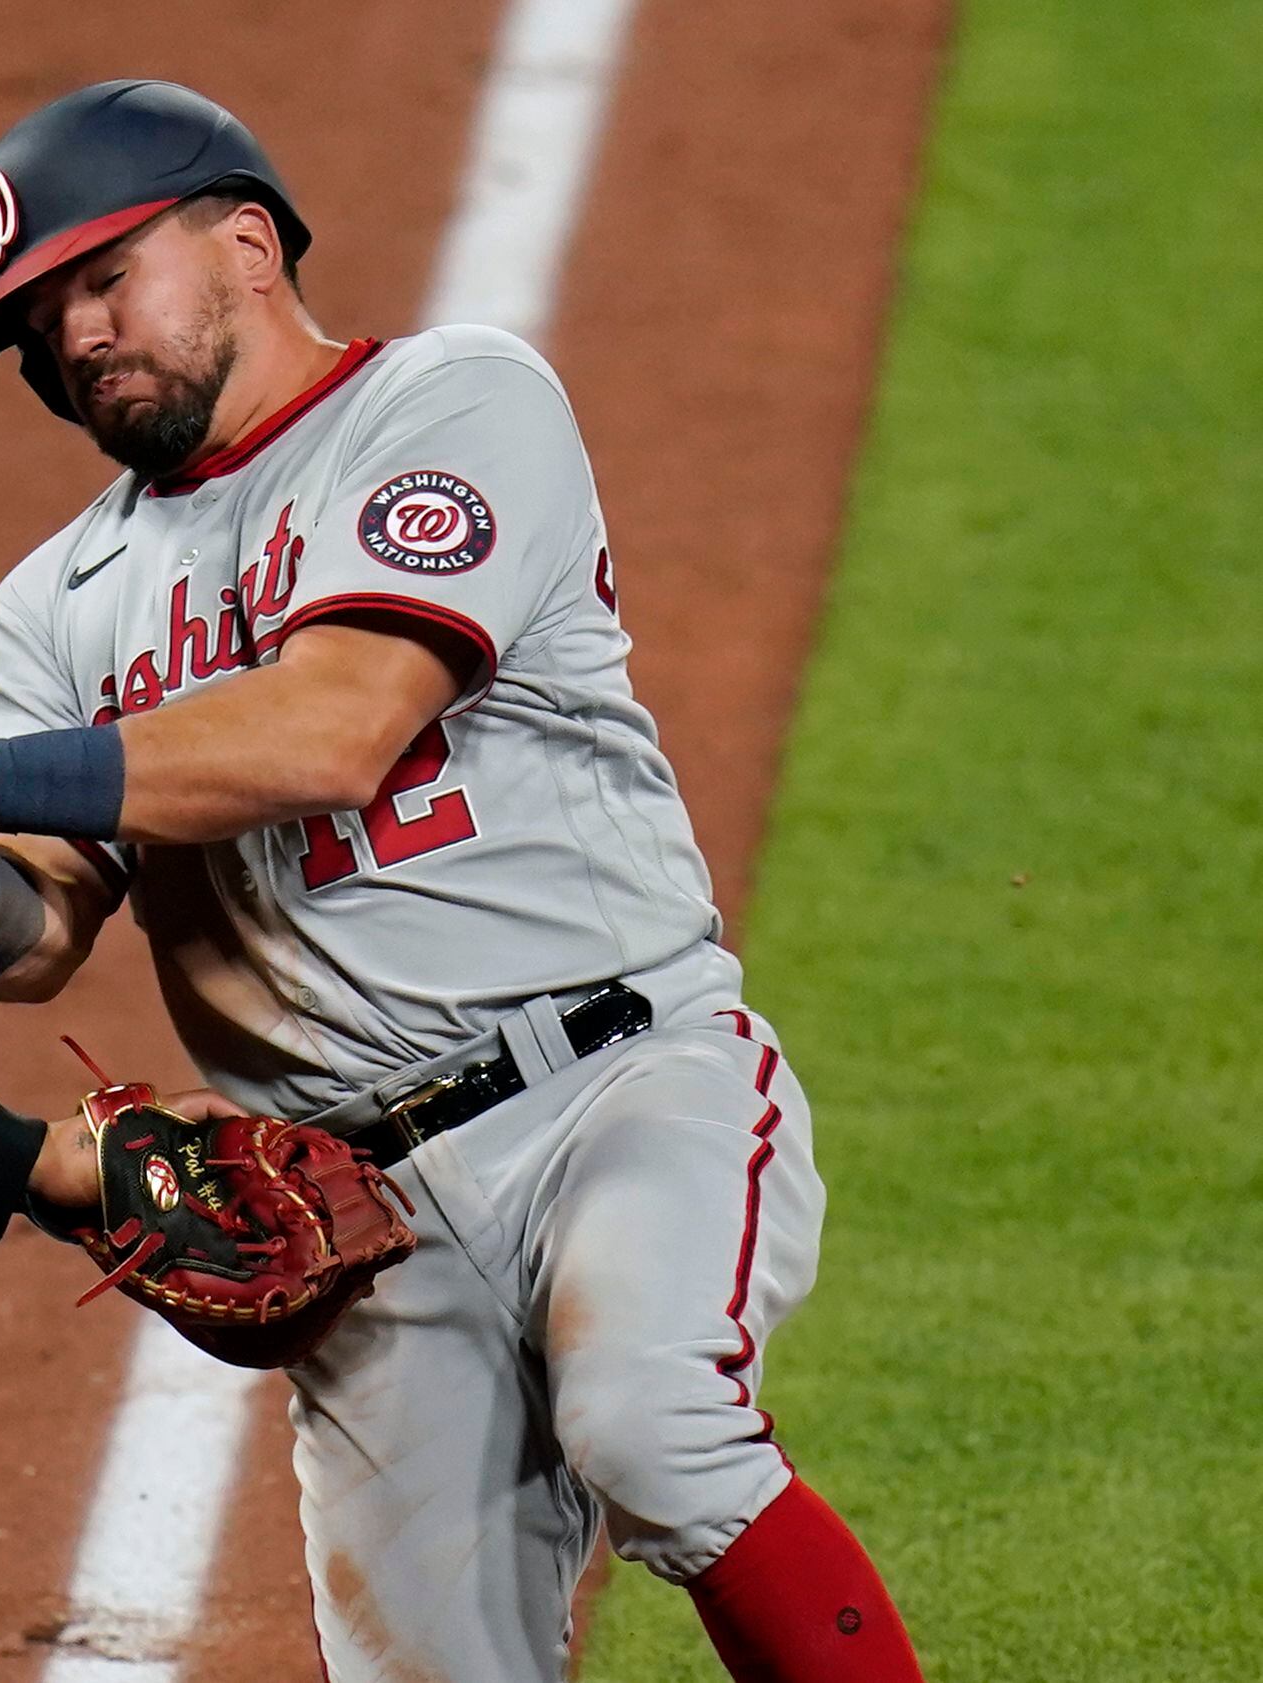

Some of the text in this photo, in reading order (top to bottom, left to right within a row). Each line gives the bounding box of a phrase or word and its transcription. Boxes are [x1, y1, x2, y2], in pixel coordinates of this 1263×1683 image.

[372, 473, 491, 530] WASHINGTON
[396, 503, 460, 543] W
[366, 531, 474, 569] NATIONALS
